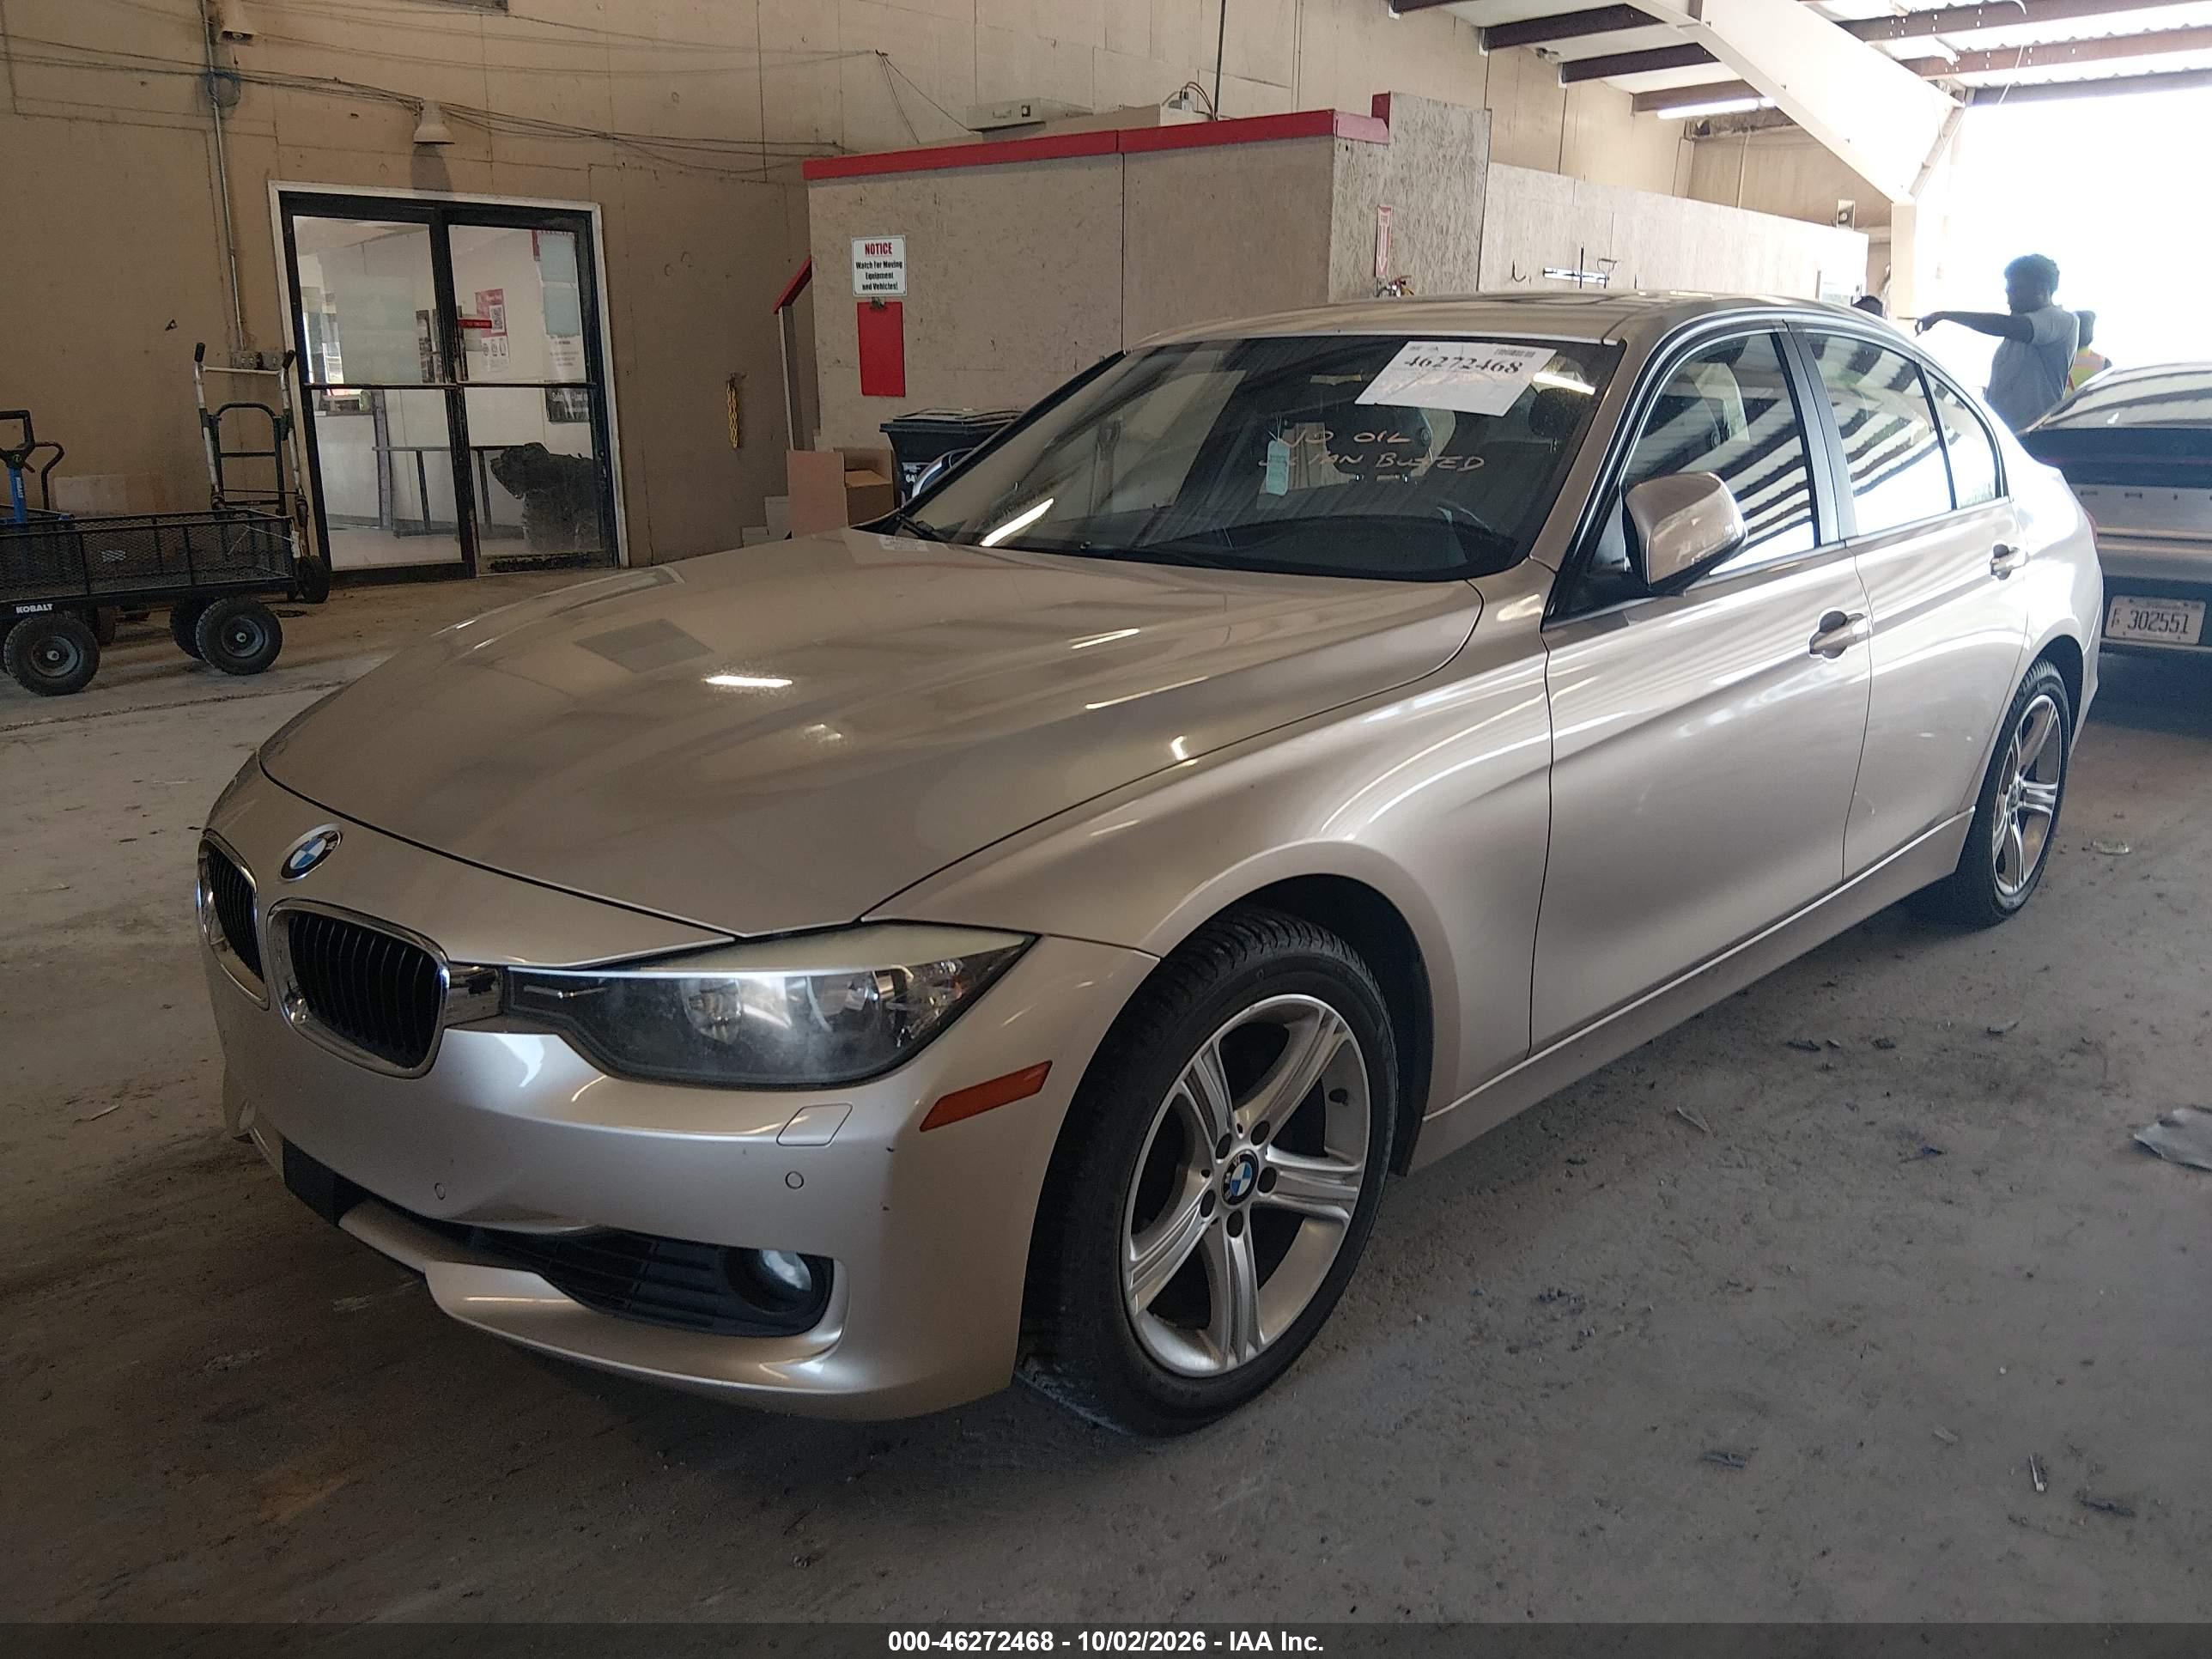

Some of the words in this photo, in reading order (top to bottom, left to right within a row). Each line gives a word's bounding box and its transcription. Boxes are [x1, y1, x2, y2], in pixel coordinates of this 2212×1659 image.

[865, 242, 892, 254] NOTICE
[855, 261, 873, 270] Watch
[883, 260, 902, 269] Moving
[873, 282, 898, 290] Vehicles!
[1404, 356, 1523, 374] 46272468
[1353, 429, 1411, 444] OIL
[15, 603, 52, 614] KOBALT
[2127, 610, 2189, 634] 302551
